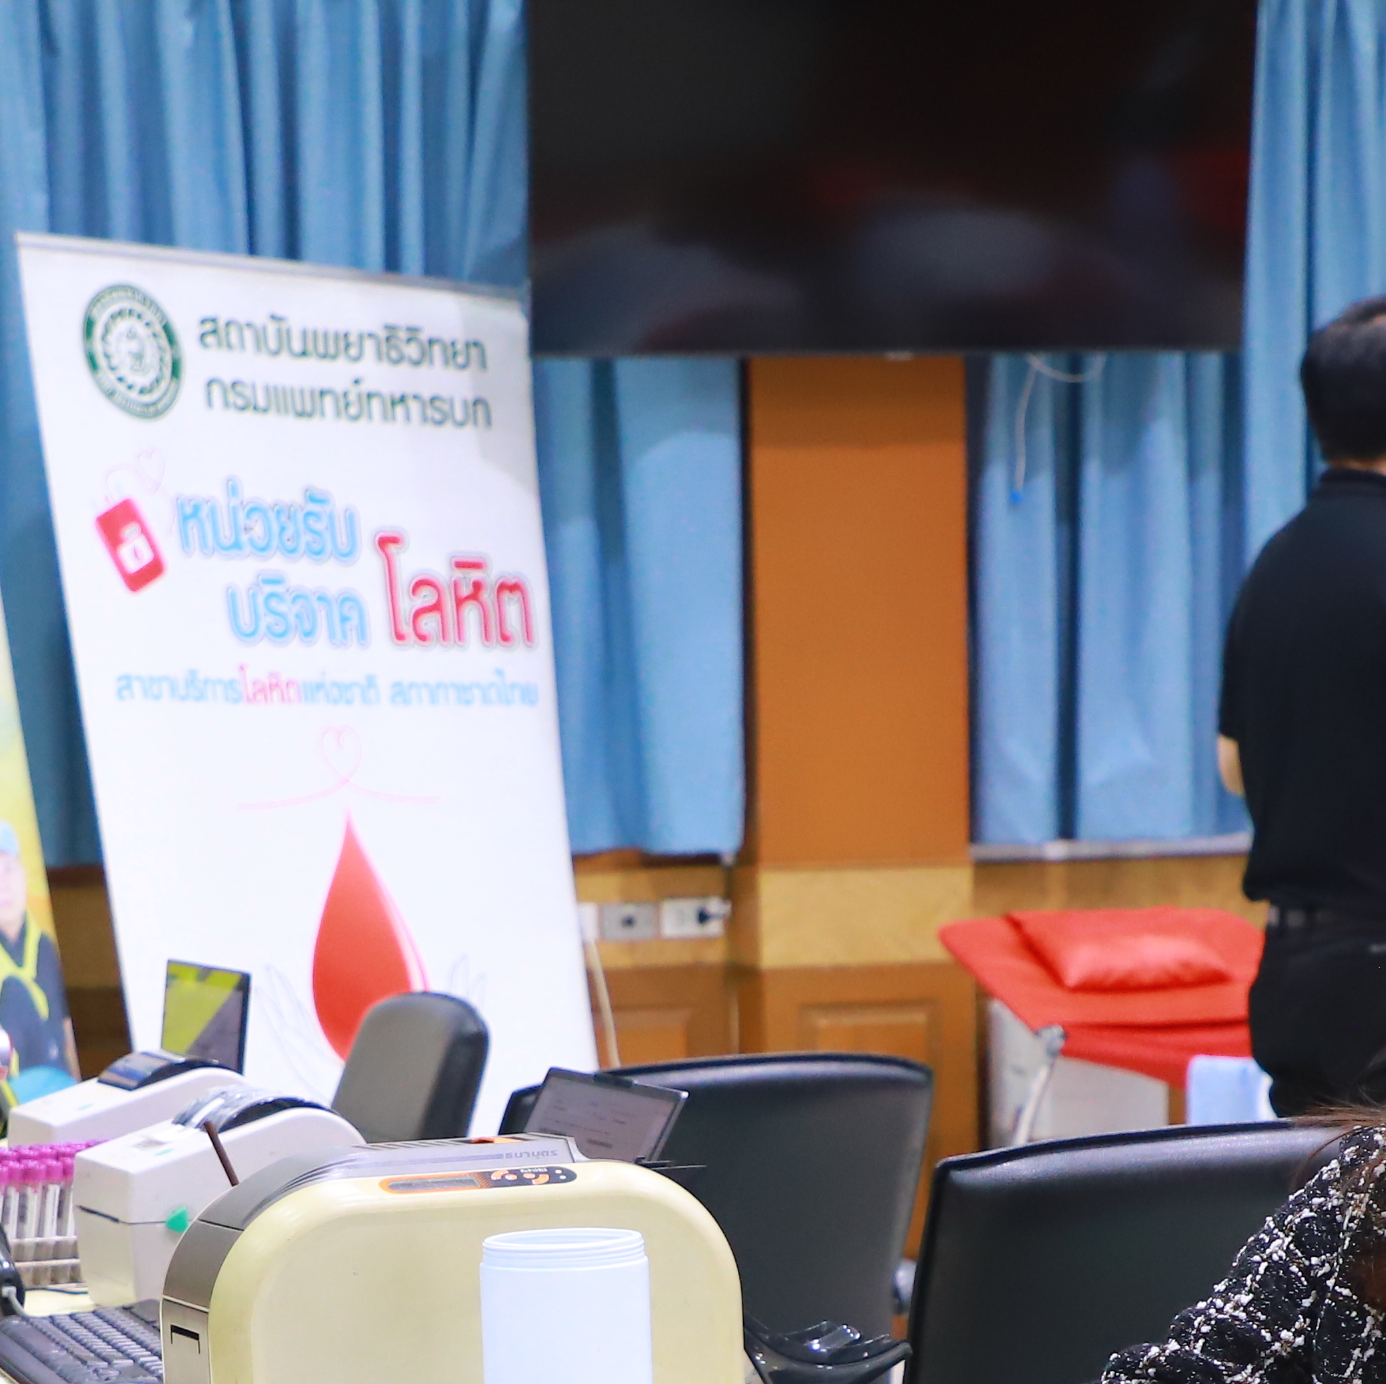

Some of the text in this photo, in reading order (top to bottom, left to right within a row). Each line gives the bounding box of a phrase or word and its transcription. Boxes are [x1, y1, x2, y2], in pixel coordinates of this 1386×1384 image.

[198, 312, 488, 371] สถาบันพยาธิวิทยา
[205, 376, 493, 430] กรมแพทย์ทหารบก
[177, 478, 360, 566] หน่วยรับ
[227, 531, 535, 648] บริจาค โลหิต
[115, 662, 540, 708] สาขาบริการโลหิตแห่งชาติ สภากาชาดไทย
